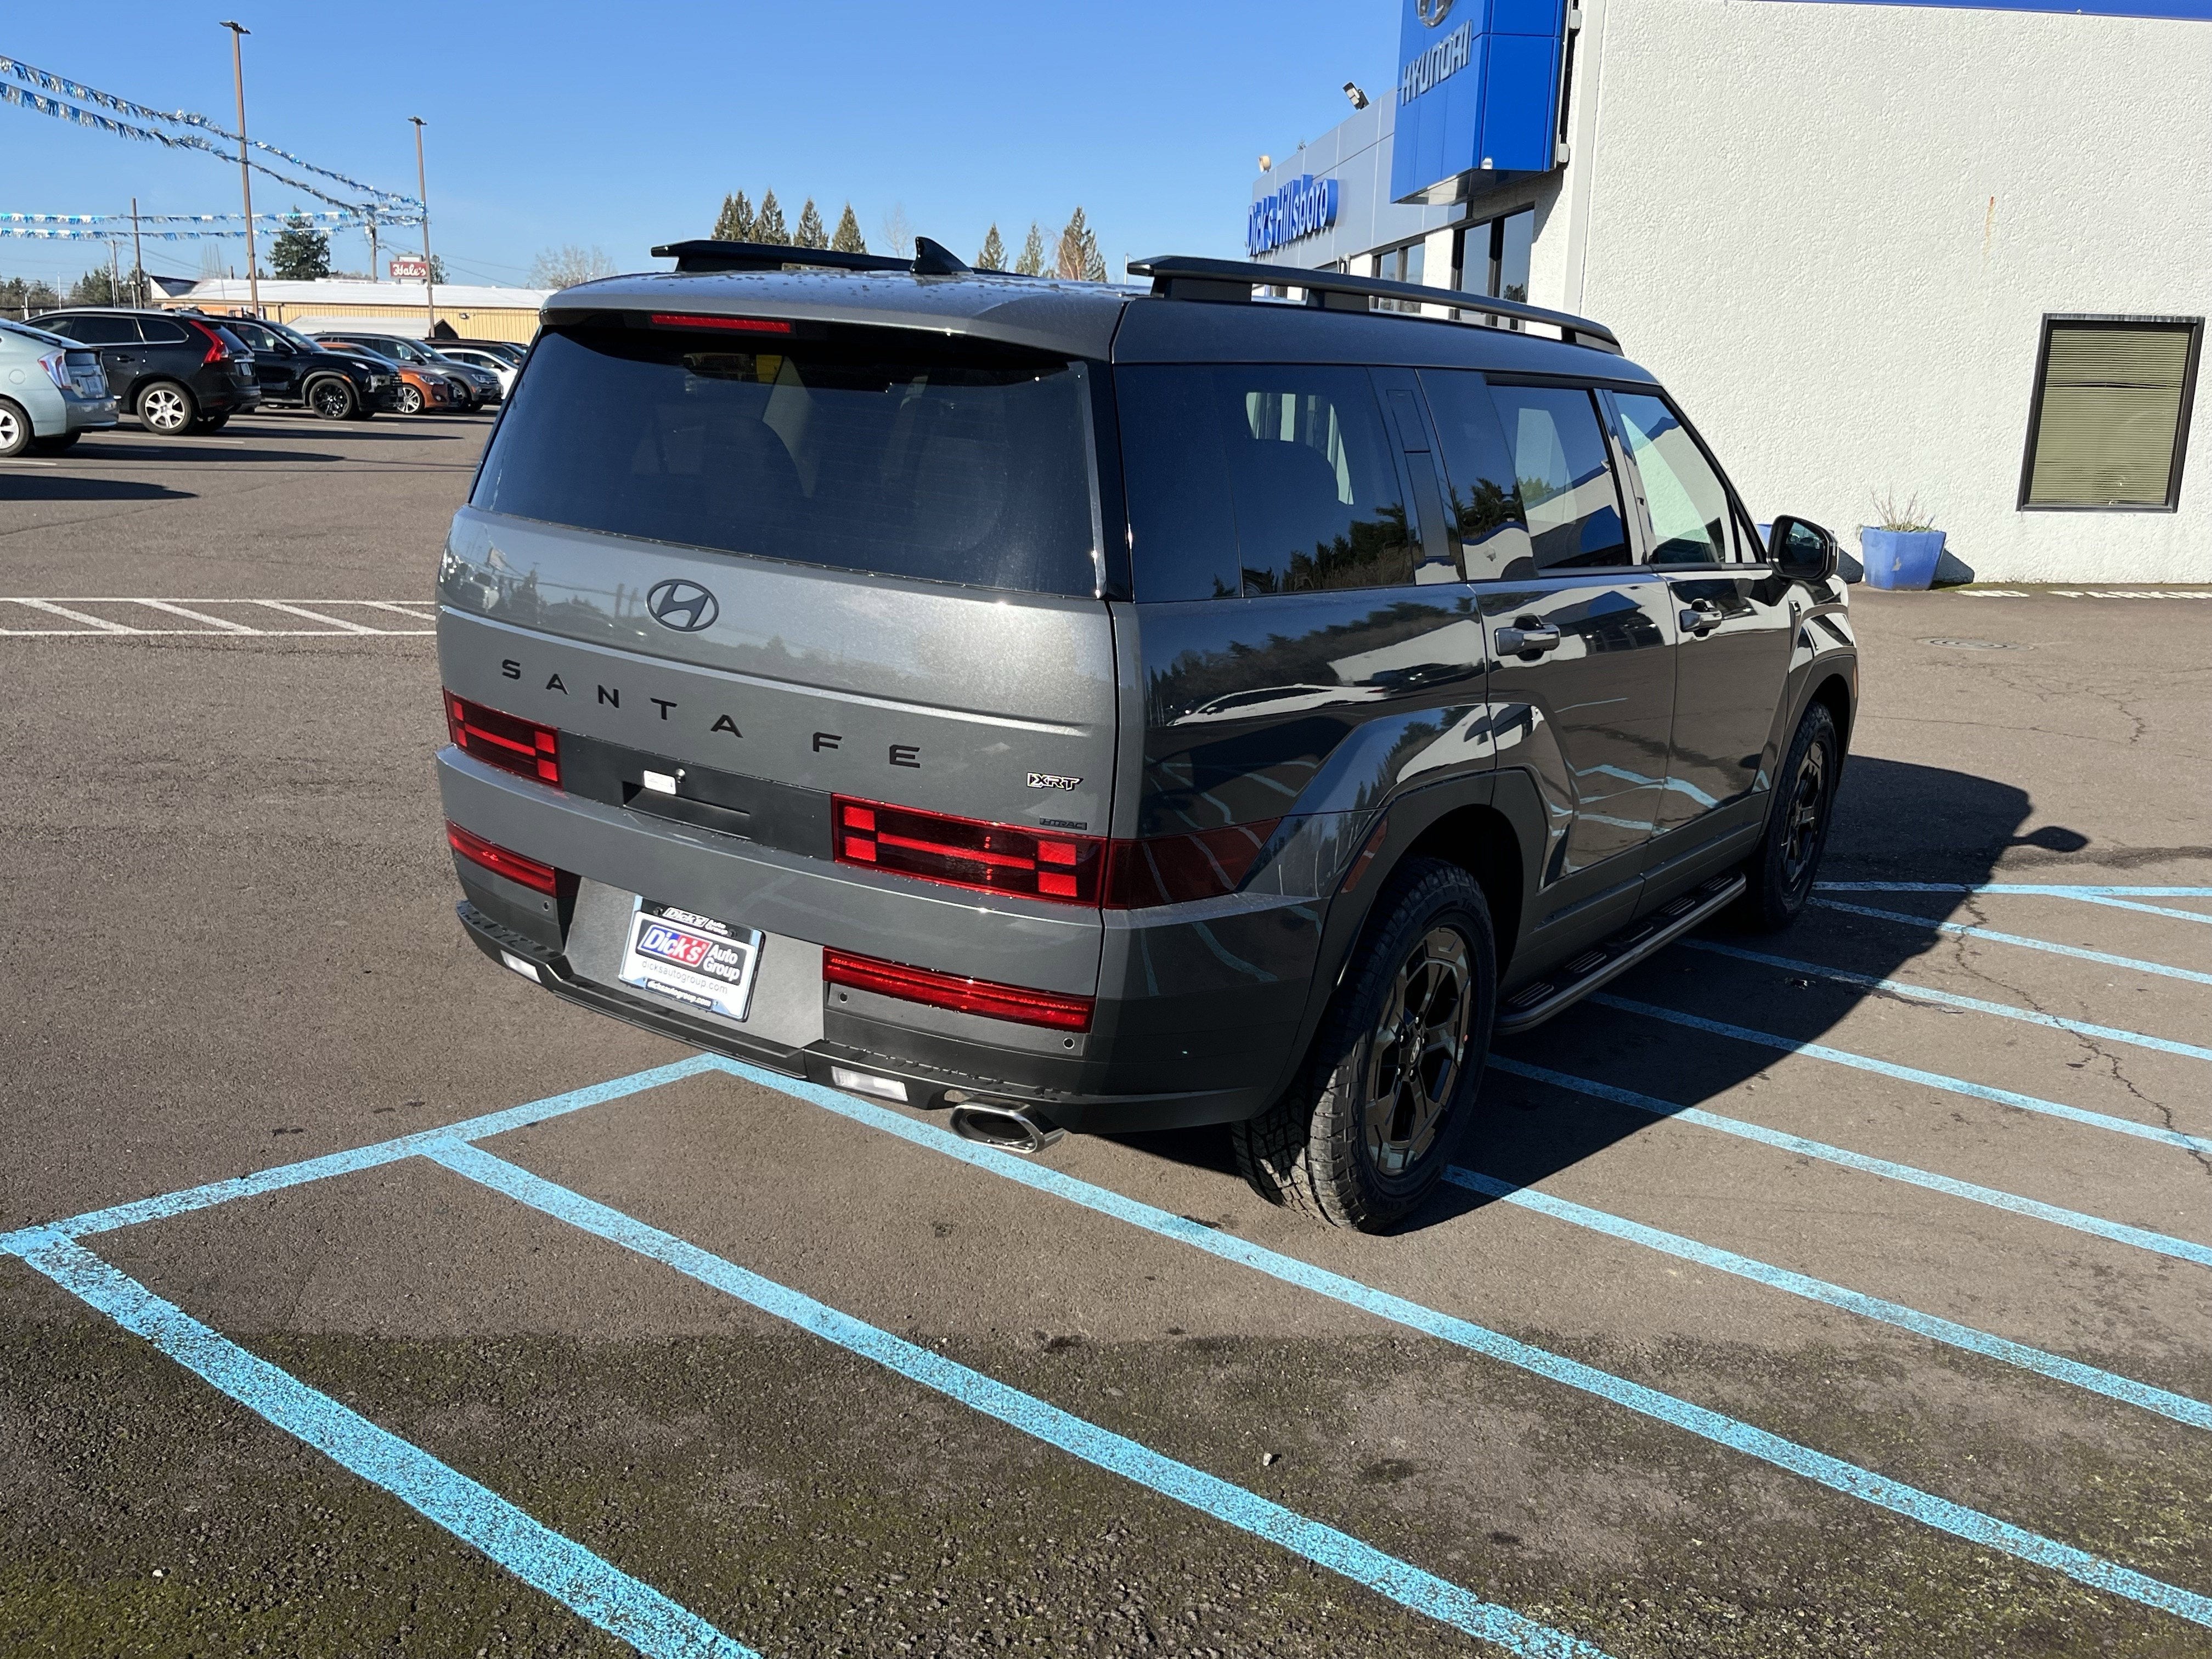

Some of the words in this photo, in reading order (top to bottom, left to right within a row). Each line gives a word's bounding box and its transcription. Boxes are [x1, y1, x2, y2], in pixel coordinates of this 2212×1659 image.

[1401, 19, 1472, 106] HYUNDAI
[1246, 196, 1275, 257] Dick's
[1275, 174, 1336, 246] Hillsboro
[392, 263, 426, 276] Hale's
[502, 659, 744, 739] SANTA
[812, 731, 921, 769] FE
[1028, 771, 1084, 791] XRT
[1041, 817, 1084, 830] HTRAC
[643, 929, 702, 962] Dick's
[707, 944, 738, 964] Auto
[642, 960, 728, 994] dicksautogroup.com
[703, 957, 741, 981] Group
